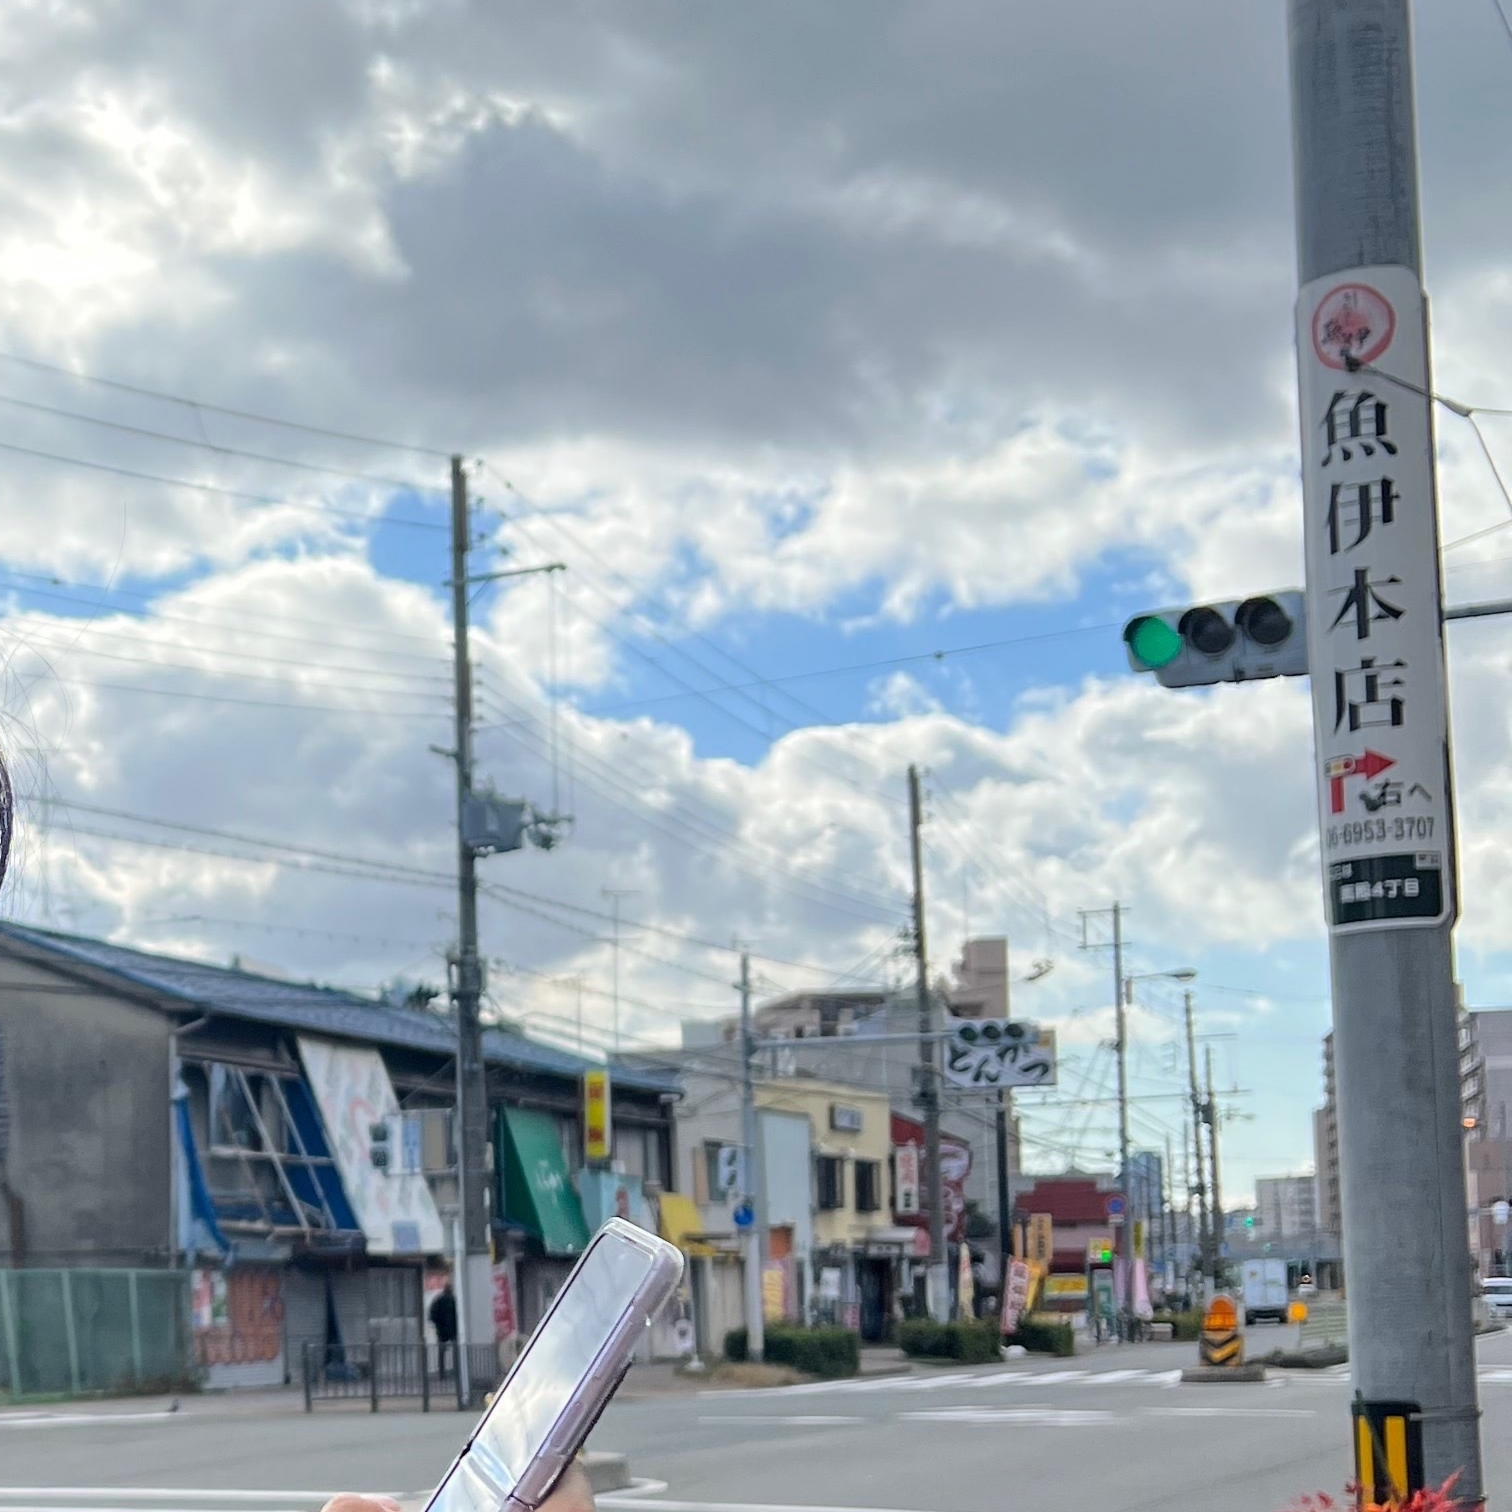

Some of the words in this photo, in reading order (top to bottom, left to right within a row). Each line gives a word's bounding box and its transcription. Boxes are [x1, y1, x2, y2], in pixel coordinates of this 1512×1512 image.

[1320, 389, 1407, 736] 魚伊本店
[948, 1040, 1049, 1083] とんかつ
